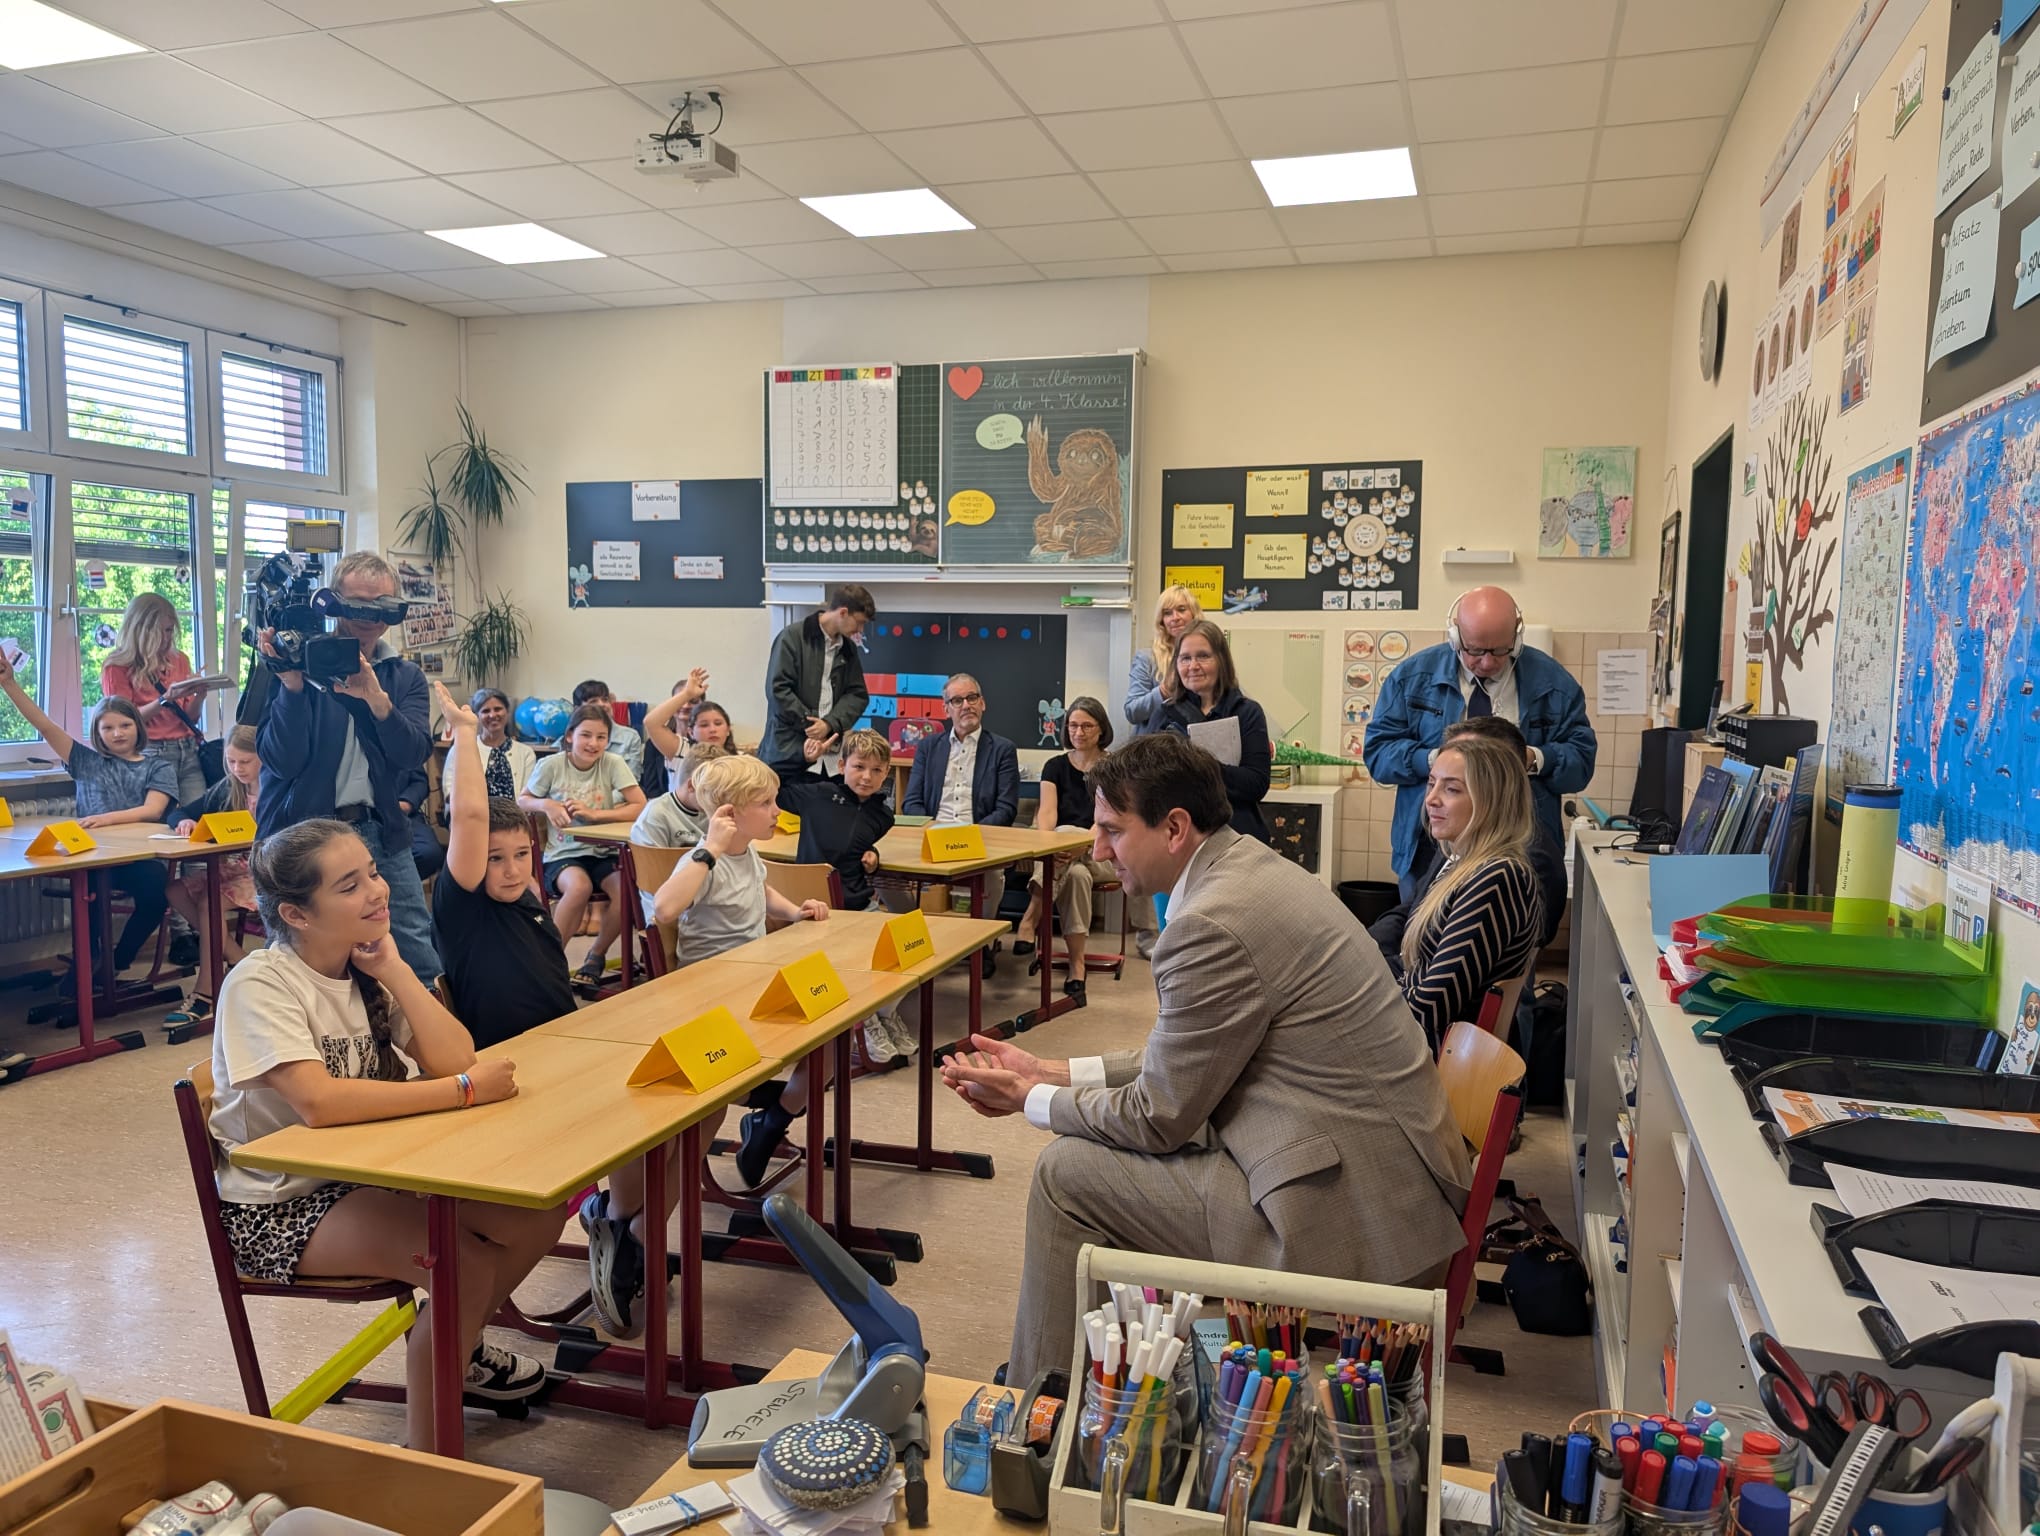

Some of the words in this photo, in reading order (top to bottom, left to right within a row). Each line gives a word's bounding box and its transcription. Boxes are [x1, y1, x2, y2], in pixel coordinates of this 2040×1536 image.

[1984, 45, 1994, 66] ist
[1971, 113, 1983, 137] mit
[2010, 106, 2036, 137] Verben,
[1969, 143, 1985, 168] Rede.
[1954, 258, 1965, 275] im
[809, 370, 822, 381] ZT
[863, 368, 870, 379] Z
[1032, 369, 1122, 389] willkommen
[1013, 396, 1033, 411] der
[1040, 392, 1054, 410] 4.
[1059, 385, 1128, 410] Klasse!
[635, 493, 677, 503] Vorbereitung
[1267, 488, 1289, 497] Wann?
[1271, 503, 1284, 511] Wo?
[1256, 553, 1294, 563] Hauptfiguren
[226, 826, 244, 835] Laura
[945, 842, 969, 851] Fabian
[903, 938, 925, 953] Johannes
[810, 982, 829, 997] Gerry
[705, 1048, 728, 1064] Zina
[723, 1381, 809, 1440] STENGELE
